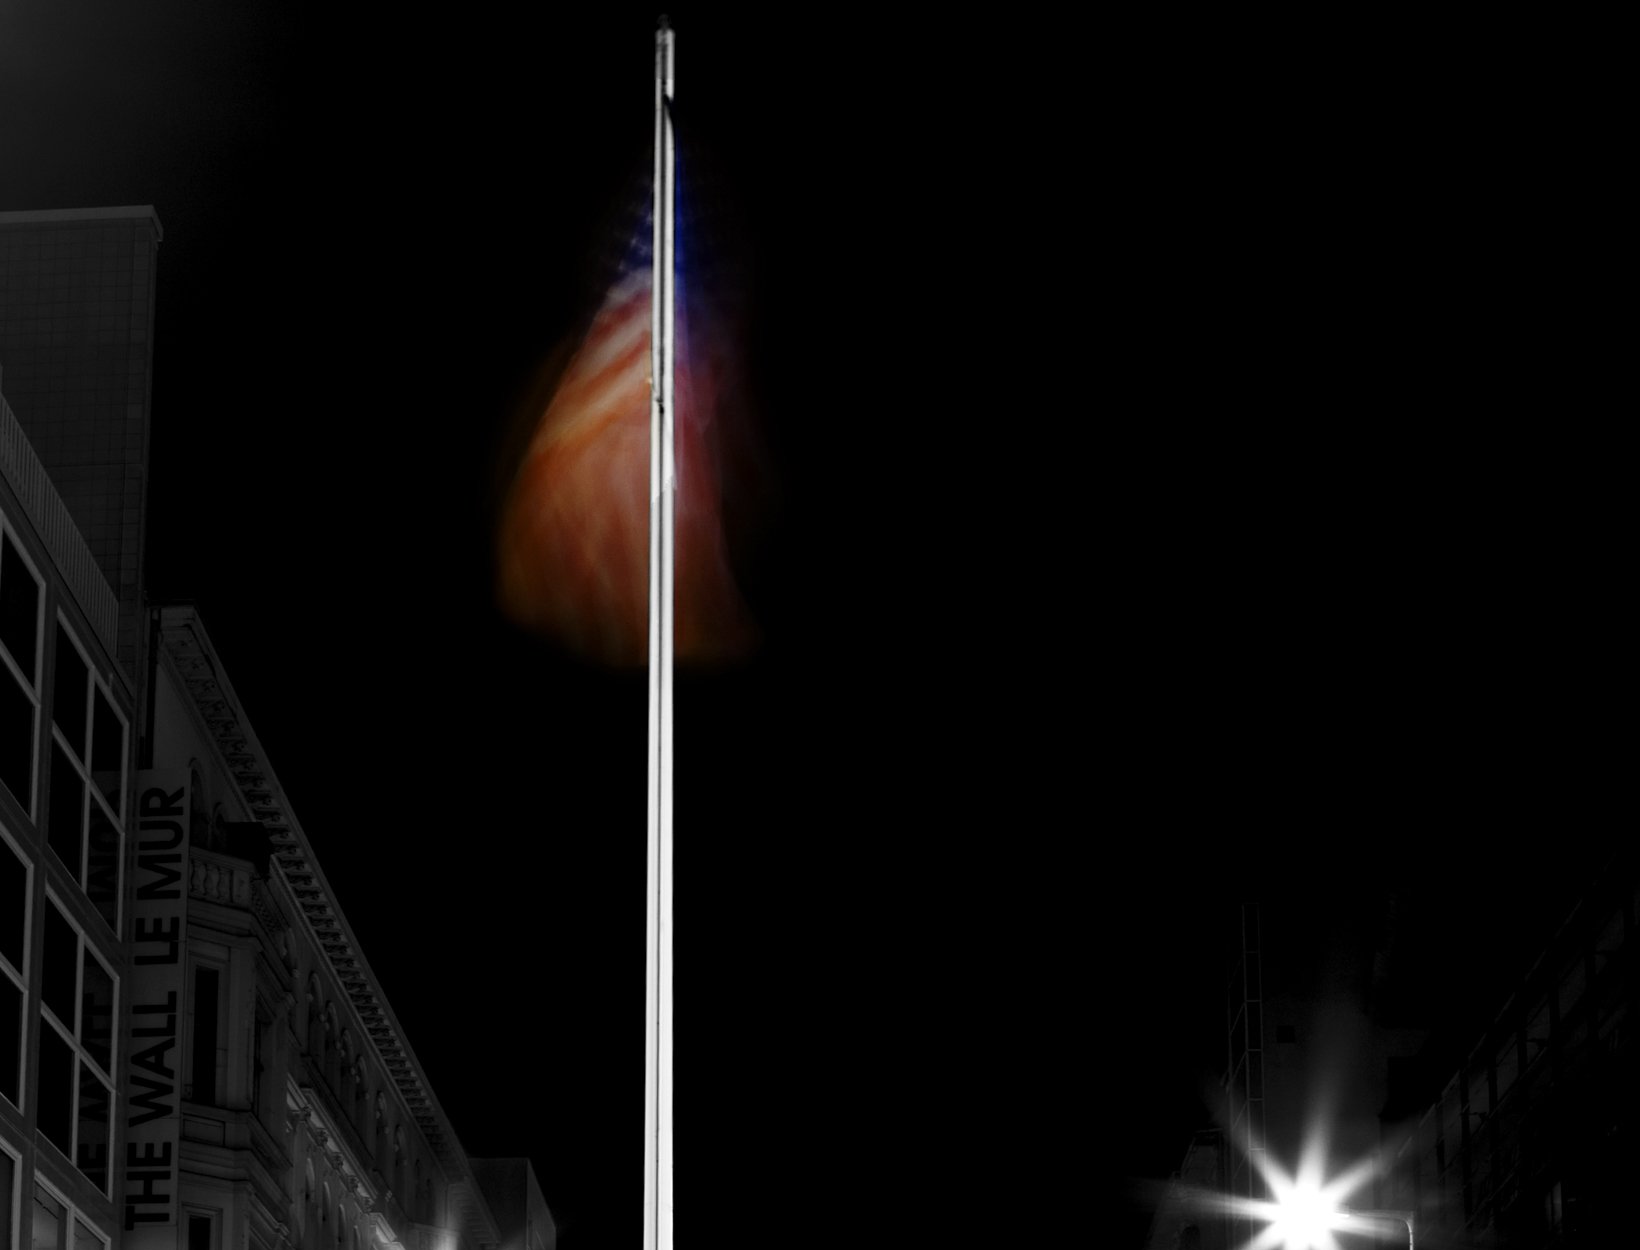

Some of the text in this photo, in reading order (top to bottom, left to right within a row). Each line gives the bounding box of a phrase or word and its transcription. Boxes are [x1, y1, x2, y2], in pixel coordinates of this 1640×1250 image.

[137, 787, 184, 900] MUR
[135, 917, 180, 965] LE
[129, 991, 177, 1127] WALL
[125, 1142, 172, 1230] THE
